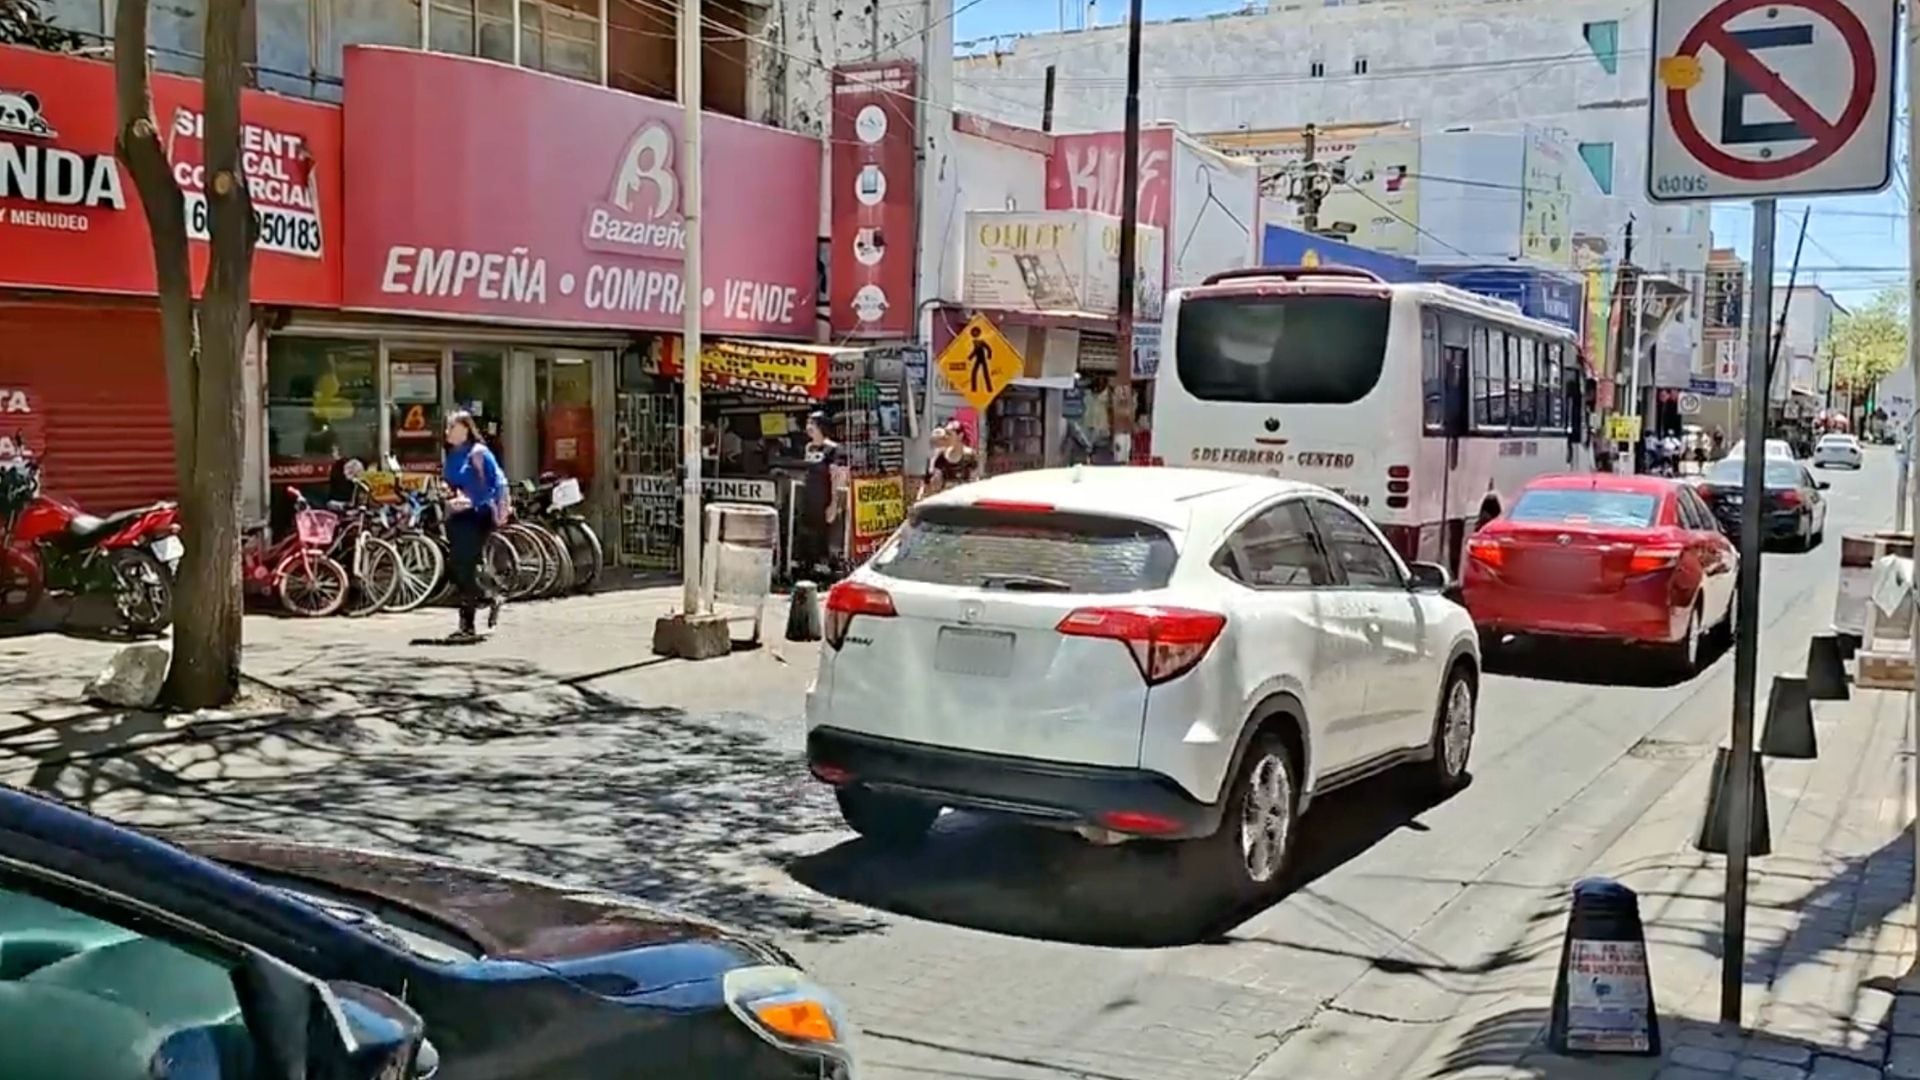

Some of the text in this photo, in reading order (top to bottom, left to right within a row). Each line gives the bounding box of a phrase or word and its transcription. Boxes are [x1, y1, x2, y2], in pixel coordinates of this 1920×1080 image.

[10, 208, 89, 231] MENUDEO
[381, 246, 547, 304] EMPEÑA
[722, 277, 798, 325] VENDE
[1201, 447, 1219, 462] DE
[1221, 449, 1285, 465] FEBRERO
[1297, 452, 1355, 468] CENTRO
